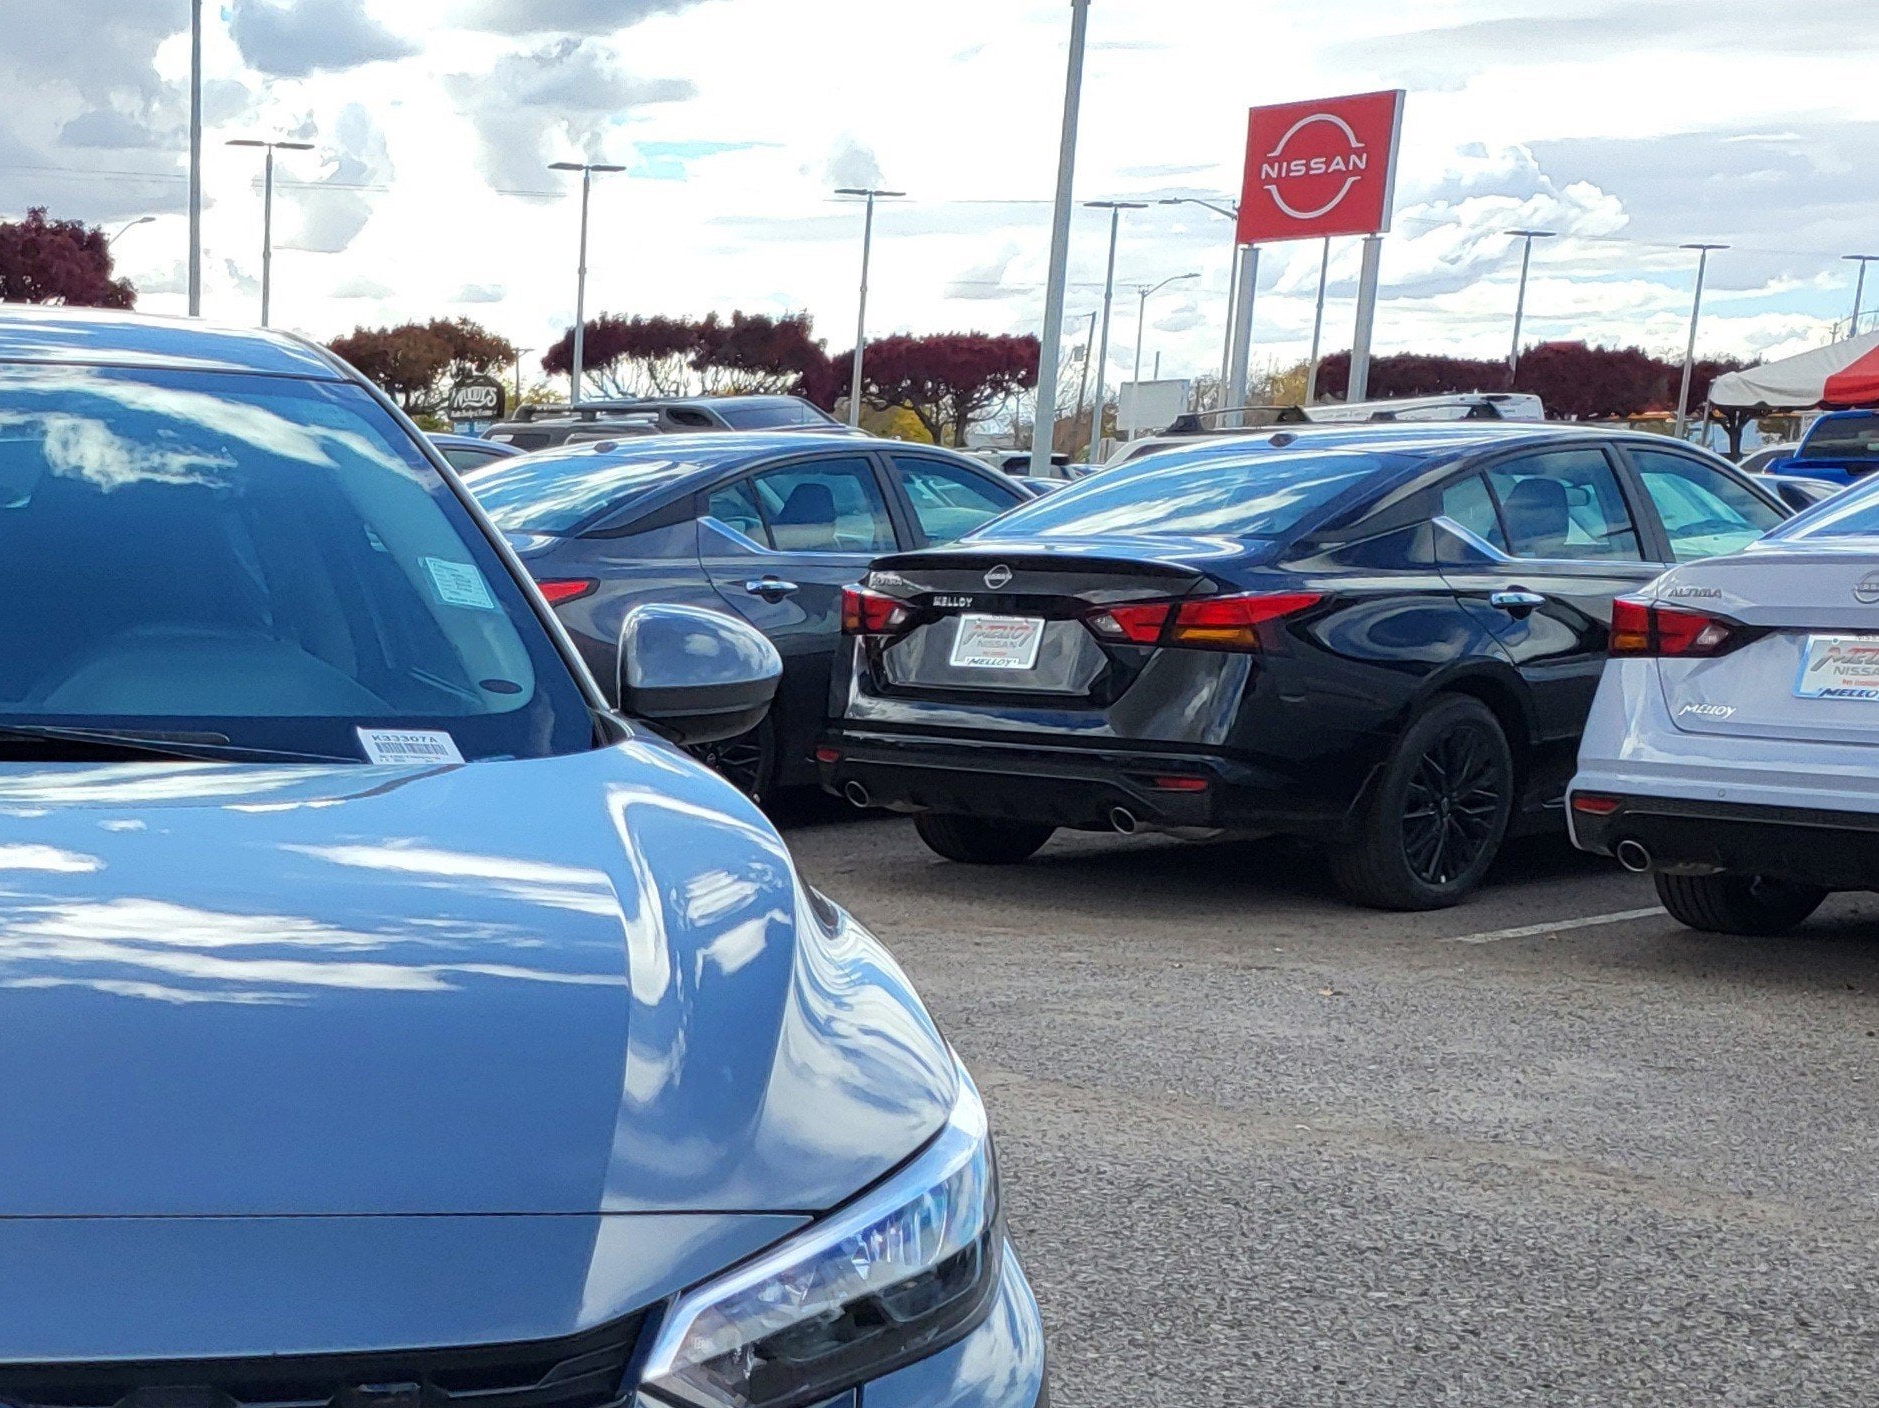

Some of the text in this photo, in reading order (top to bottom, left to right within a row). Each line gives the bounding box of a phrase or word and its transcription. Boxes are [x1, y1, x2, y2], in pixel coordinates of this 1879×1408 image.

[1261, 153, 1367, 179] NISSAN
[1668, 588, 1722, 598] ALTIMA
[933, 596, 973, 607] MELLOY
[1833, 665, 1879, 676] NISSA
[1819, 687, 1879, 698] MELLO
[1678, 703, 1737, 719] MELLOY
